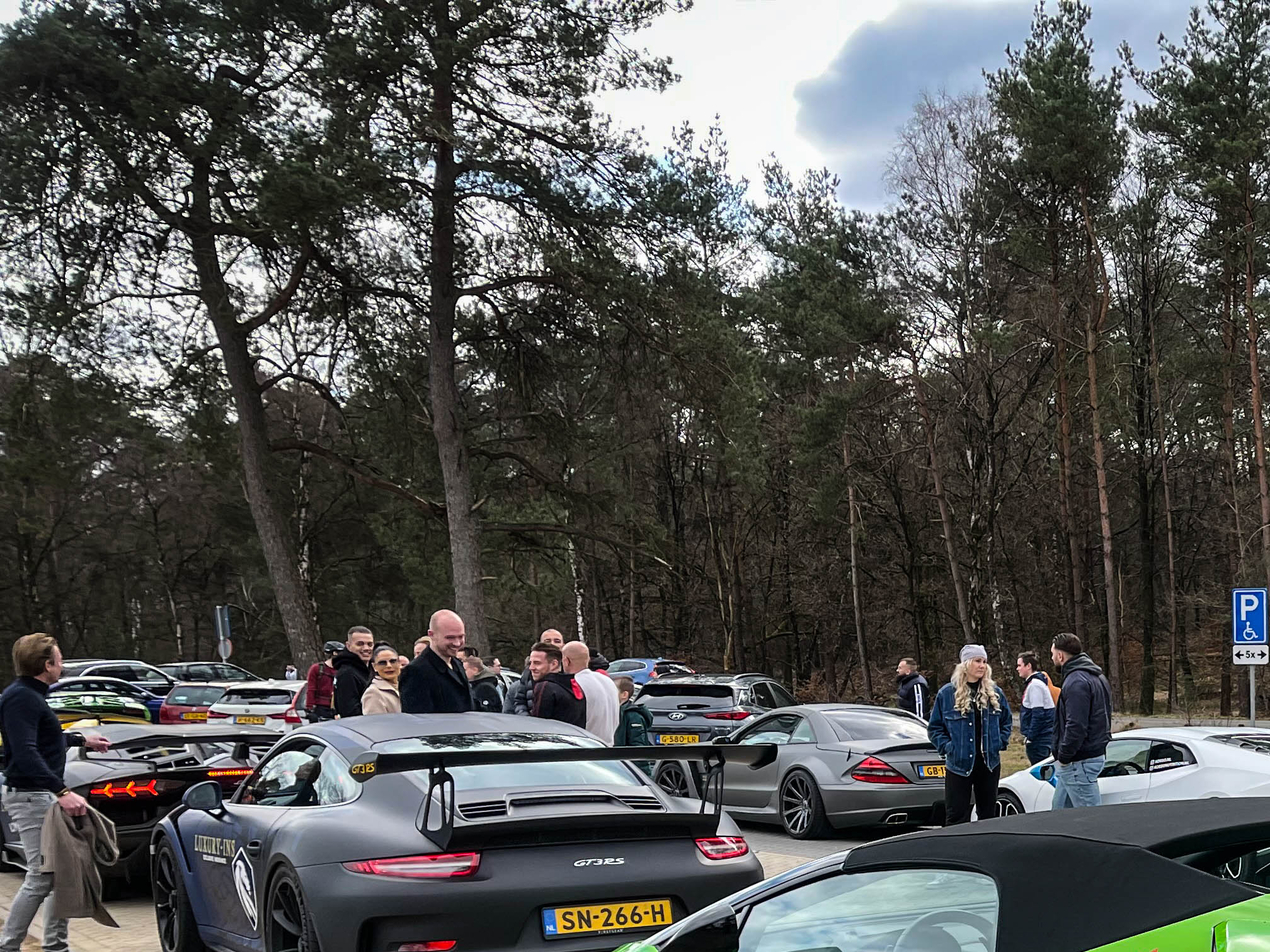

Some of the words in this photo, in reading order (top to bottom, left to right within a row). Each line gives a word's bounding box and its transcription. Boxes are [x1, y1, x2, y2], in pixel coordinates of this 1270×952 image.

[1241, 595, 1259, 621] P
[1245, 650, 1256, 659] 5x
[661, 735, 697, 743] G-580-LR
[561, 903, 666, 931] SN-266-H
